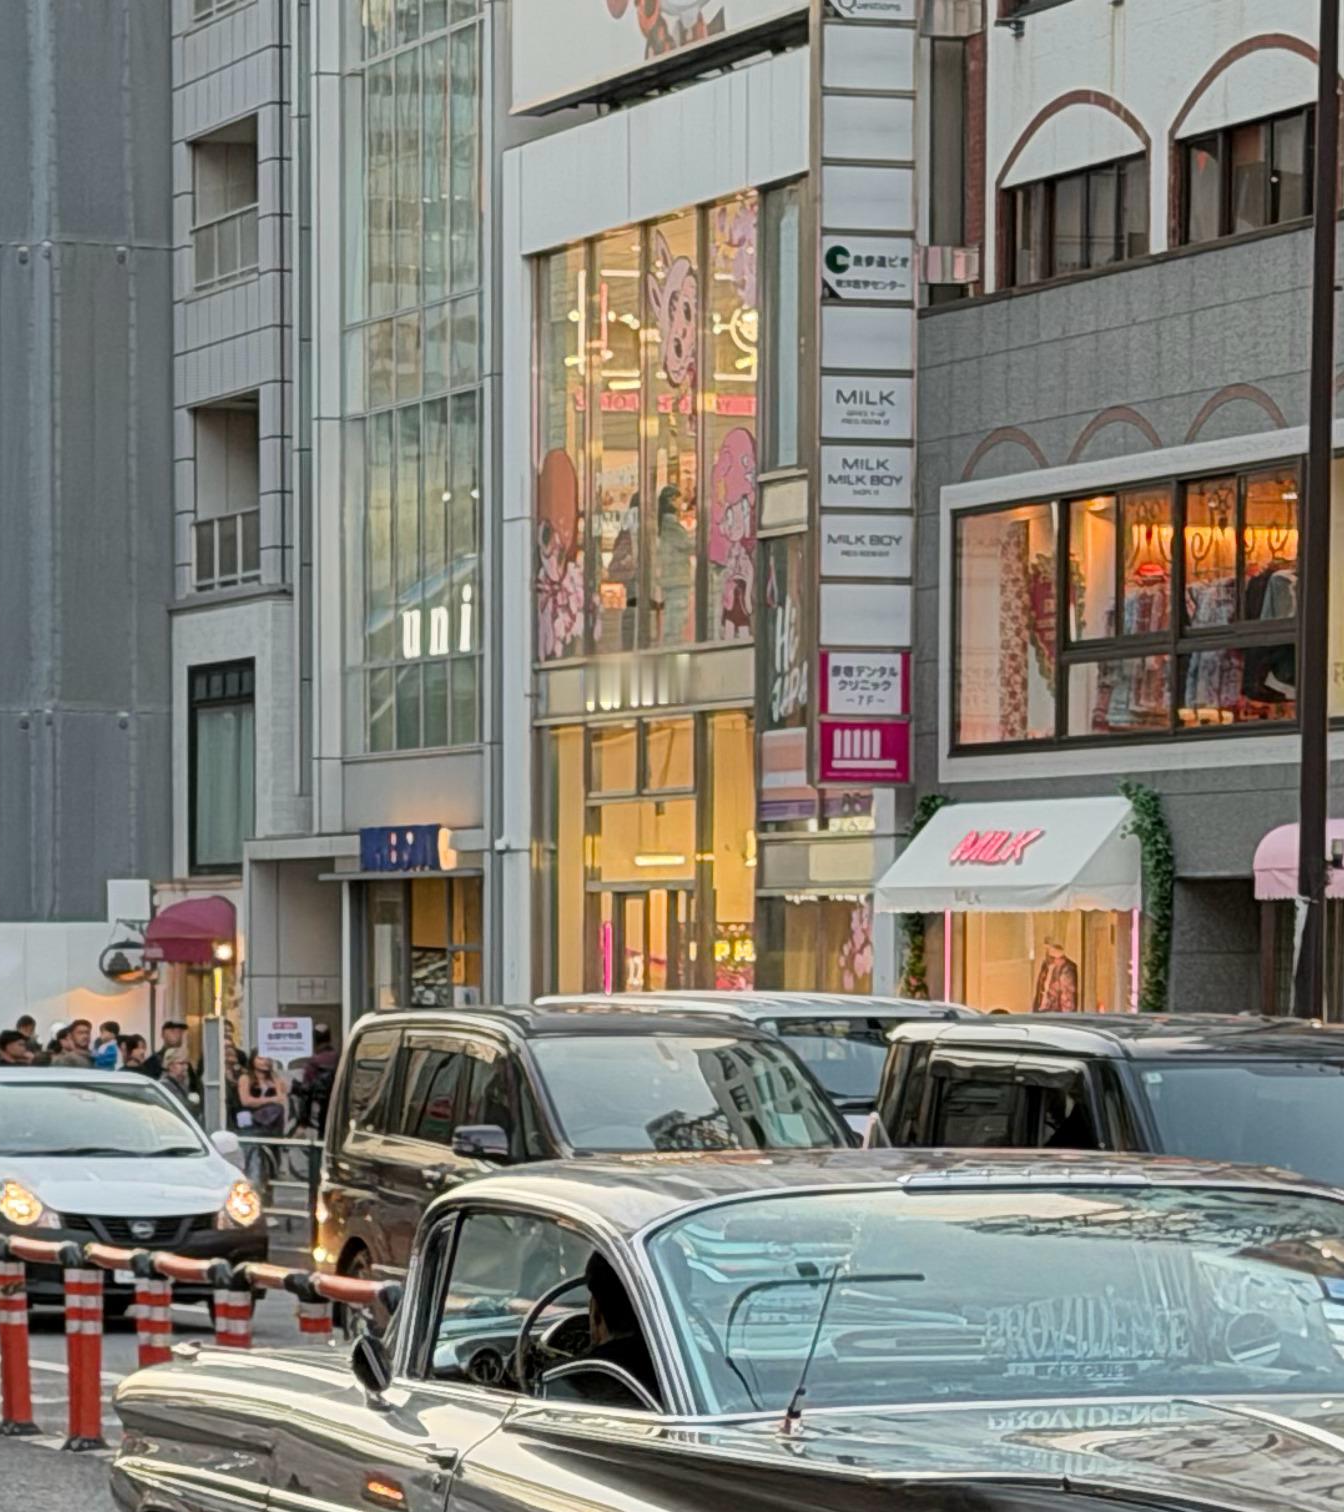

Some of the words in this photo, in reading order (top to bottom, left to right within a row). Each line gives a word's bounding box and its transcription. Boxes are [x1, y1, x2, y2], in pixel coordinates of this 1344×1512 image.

[836, 388, 895, 406] MILK
[842, 458, 889, 471] MILK
[828, 474, 866, 486] MILK
[870, 475, 903, 487] BOY
[827, 533, 865, 546] MILK
[869, 534, 903, 547] BOY
[949, 827, 1046, 866] MILK
